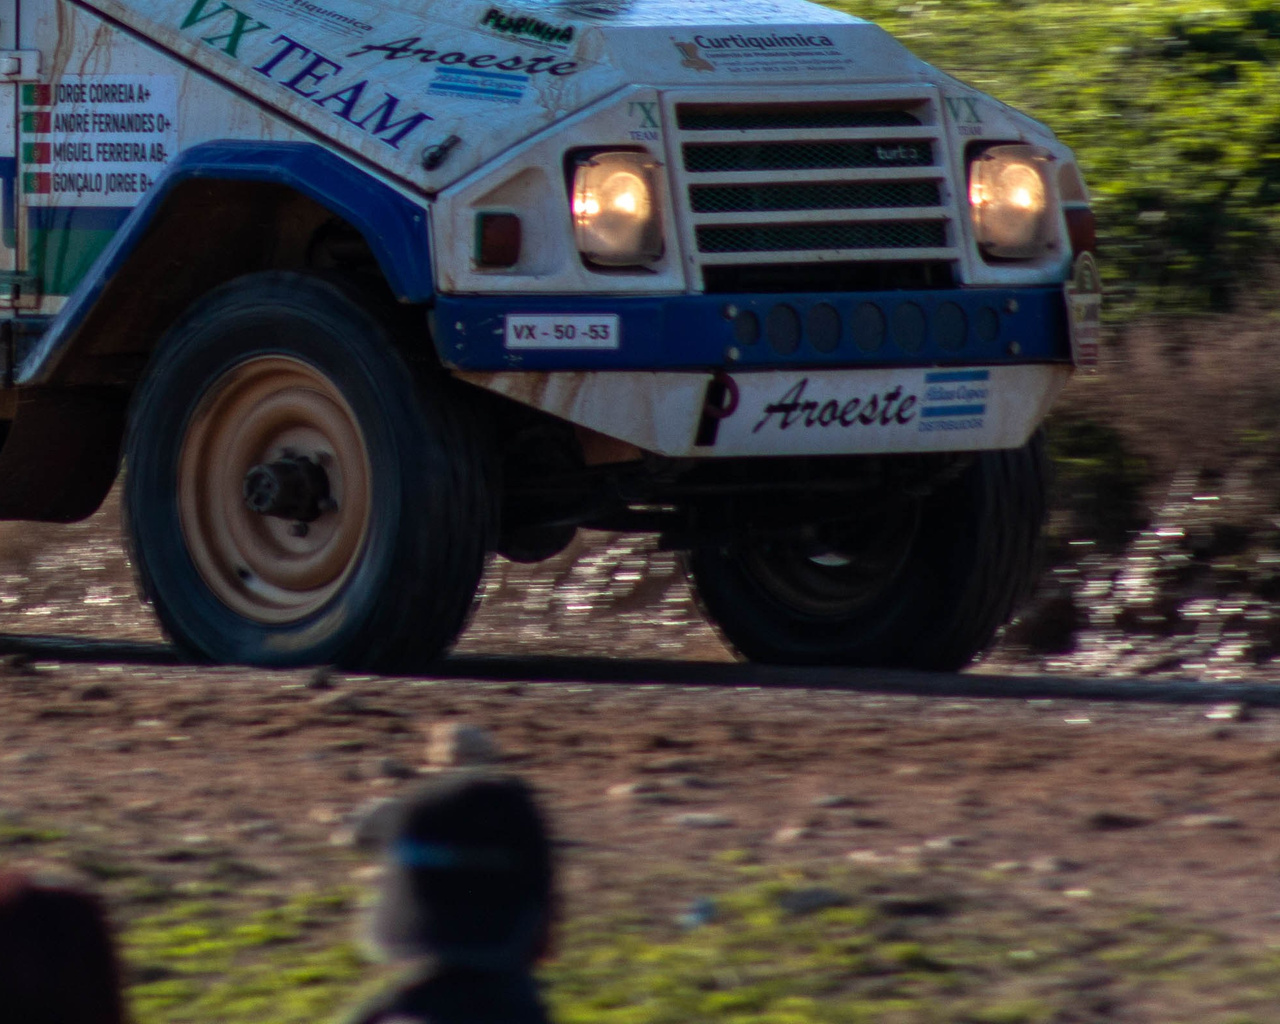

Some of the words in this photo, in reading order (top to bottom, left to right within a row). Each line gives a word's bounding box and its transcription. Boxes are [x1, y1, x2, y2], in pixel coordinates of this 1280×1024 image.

[694, 33, 834, 50] Curtiquímica
[347, 37, 579, 77] Aroeste
[53, 84, 87, 106] JORGE
[89, 84, 134, 103] CORREIA
[137, 84, 151, 103] A+
[252, 34, 434, 150] TEAM
[944, 97, 983, 123] VX
[92, 113, 155, 133] FERNANDES
[629, 131, 658, 140] TEAM
[54, 142, 93, 162] MIGUEL
[96, 143, 147, 162] FERREIRA
[53, 173, 102, 197] GONÇALO
[104, 174, 137, 195] JORGE
[140, 174, 154, 192] B+
[513, 324, 536, 340] VX
[553, 324, 576, 340] 50
[752, 378, 917, 433] Aroeste
